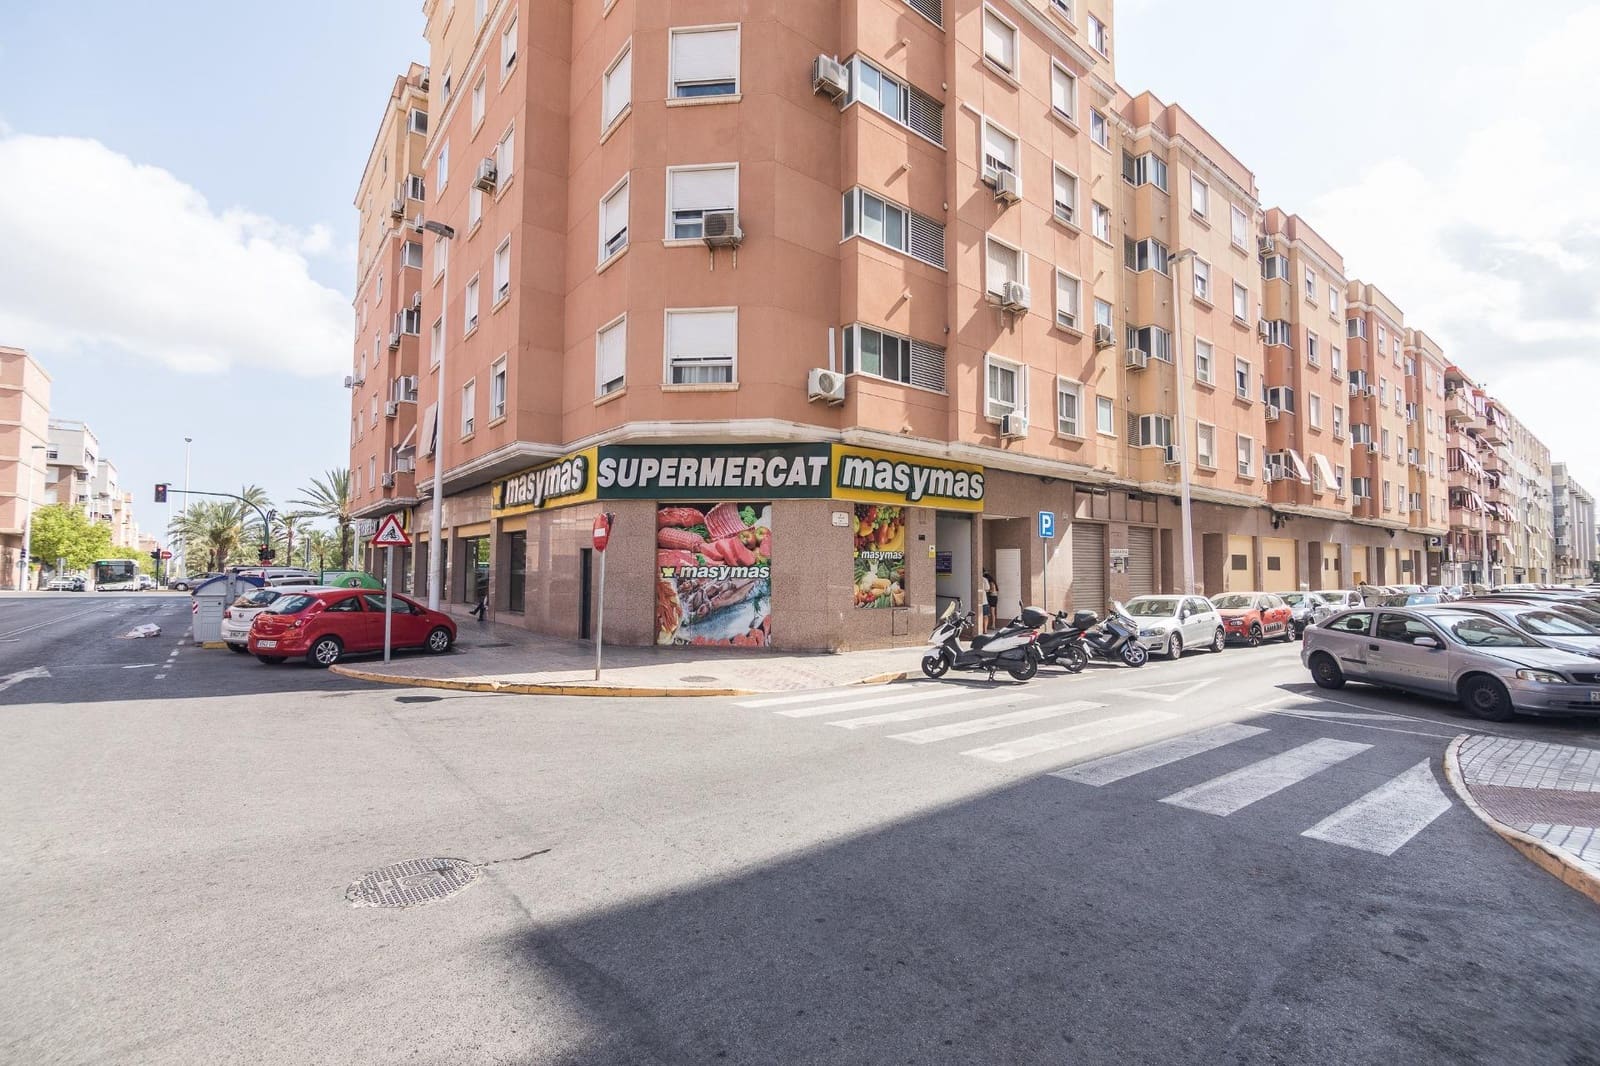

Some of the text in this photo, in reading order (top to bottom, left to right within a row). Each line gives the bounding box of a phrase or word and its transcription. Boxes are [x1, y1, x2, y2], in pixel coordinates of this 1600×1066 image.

[505, 456, 584, 507] masymas
[597, 456, 829, 488] SUPERMERCAT
[841, 456, 985, 501] masymas
[1041, 514, 1052, 535] P
[1429, 536, 1439, 547] P
[861, 550, 904, 561] masymas
[679, 565, 771, 581] masymas
